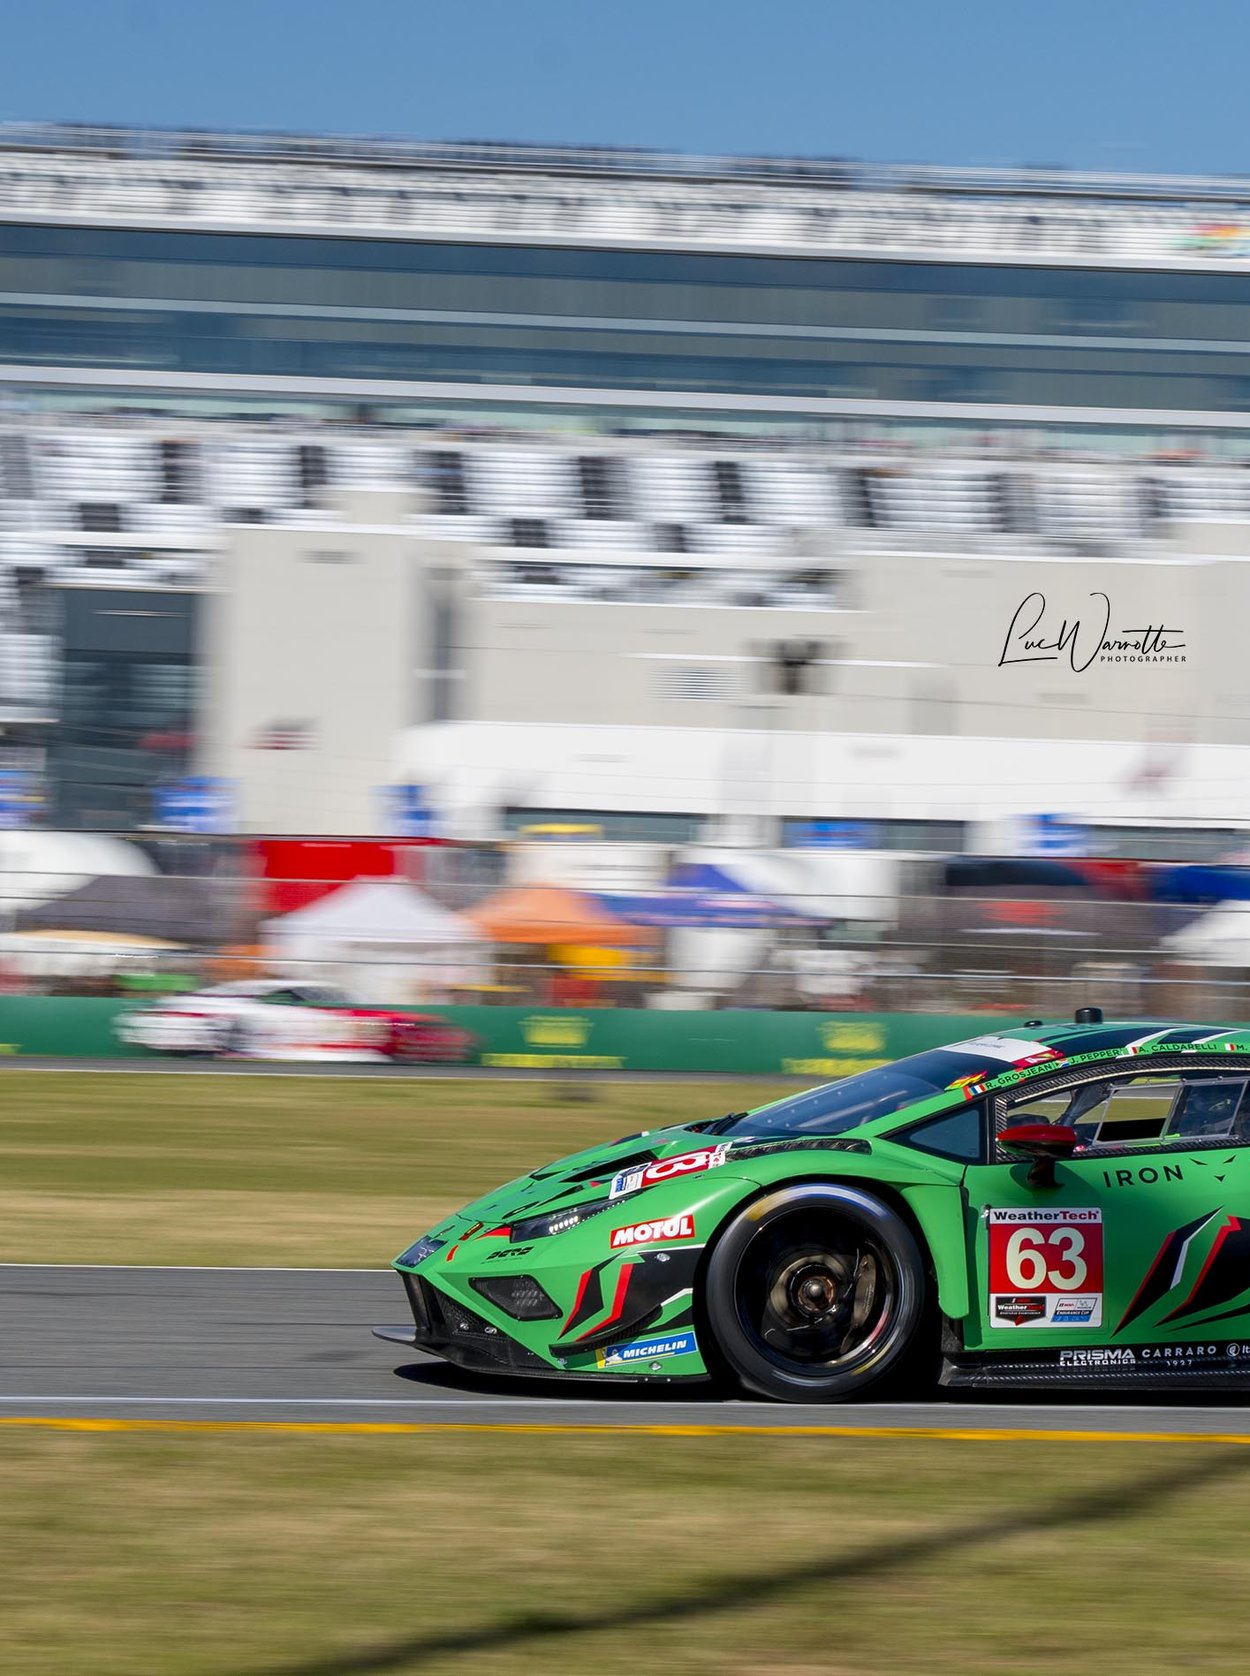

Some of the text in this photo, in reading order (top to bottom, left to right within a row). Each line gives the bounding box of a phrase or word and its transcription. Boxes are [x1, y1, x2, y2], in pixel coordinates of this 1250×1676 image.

[1151, 1043, 1217, 1052] CALDARELLI
[1069, 1050, 1121, 1064] J. PEPPER
[984, 1063, 1053, 1089] R. GROSJEAN
[1103, 1164, 1184, 1188] IRON
[994, 1211, 1098, 1221] WeatherTech
[612, 1217, 692, 1246] MOTUL
[1006, 1227, 1087, 1290] 63
[623, 1340, 687, 1358] MICHELIN
[1060, 1348, 1136, 1361] PRISMA
[1142, 1345, 1217, 1358] CARRARO
[1060, 1358, 1136, 1367] ELECTRONICS
